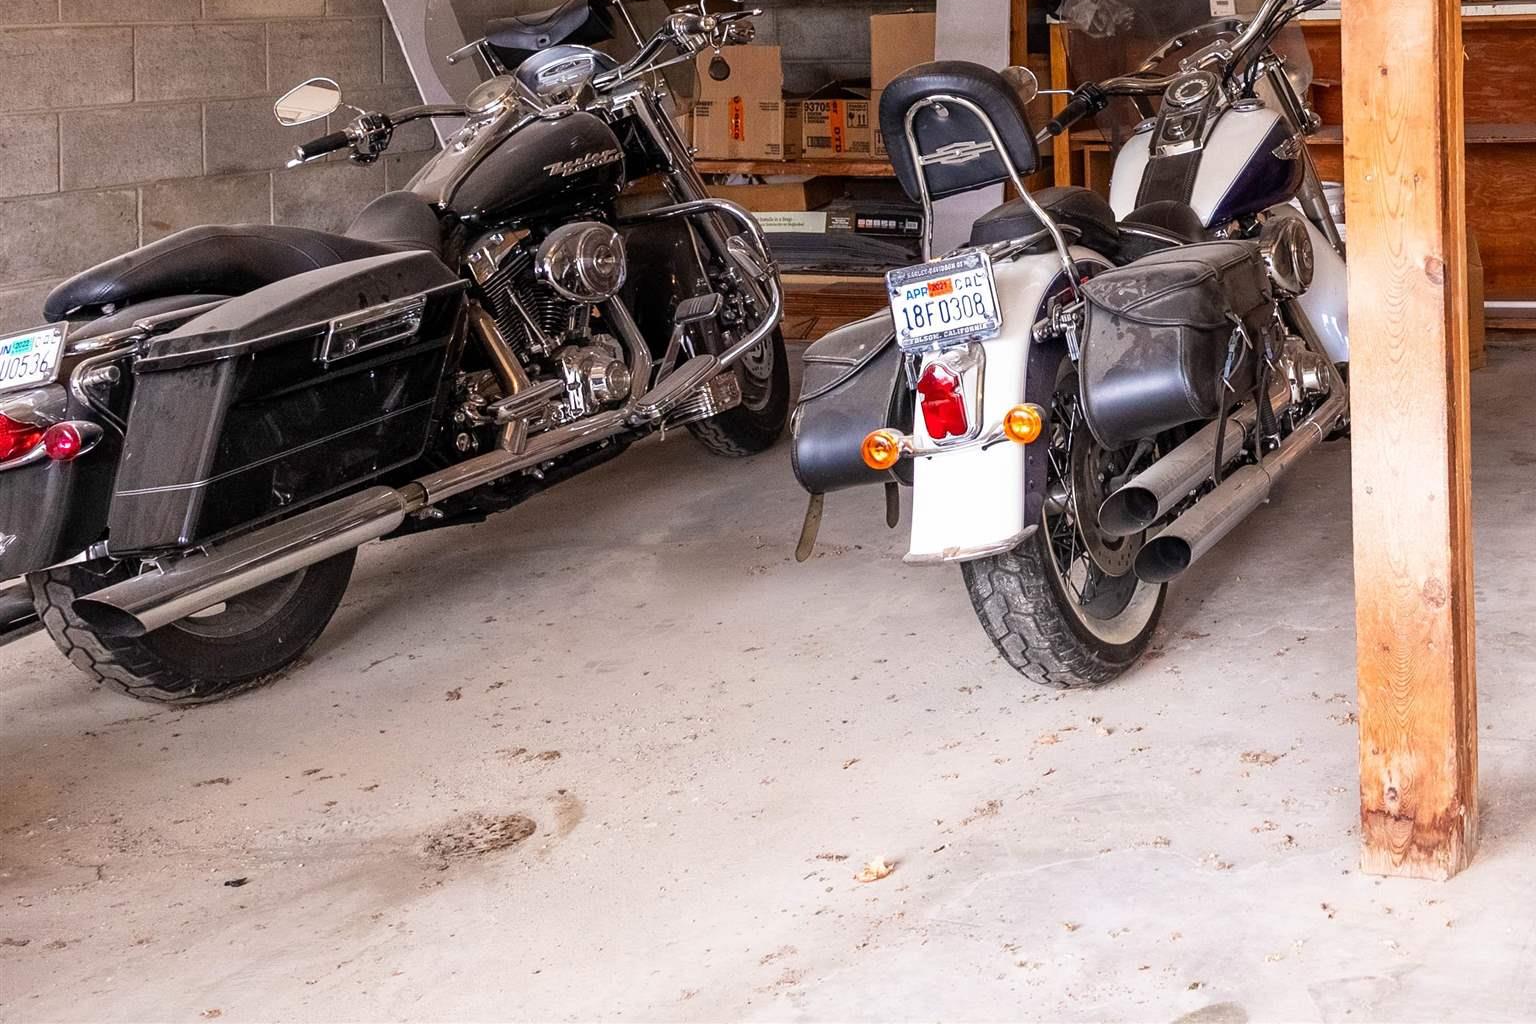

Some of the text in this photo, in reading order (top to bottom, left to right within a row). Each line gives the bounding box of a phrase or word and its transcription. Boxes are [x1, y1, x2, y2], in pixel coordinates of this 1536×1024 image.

[906, 281, 948, 301] APR 2021
[902, 293, 986, 331] 18F0308
[943, 323, 987, 337] CALIFORNIA
